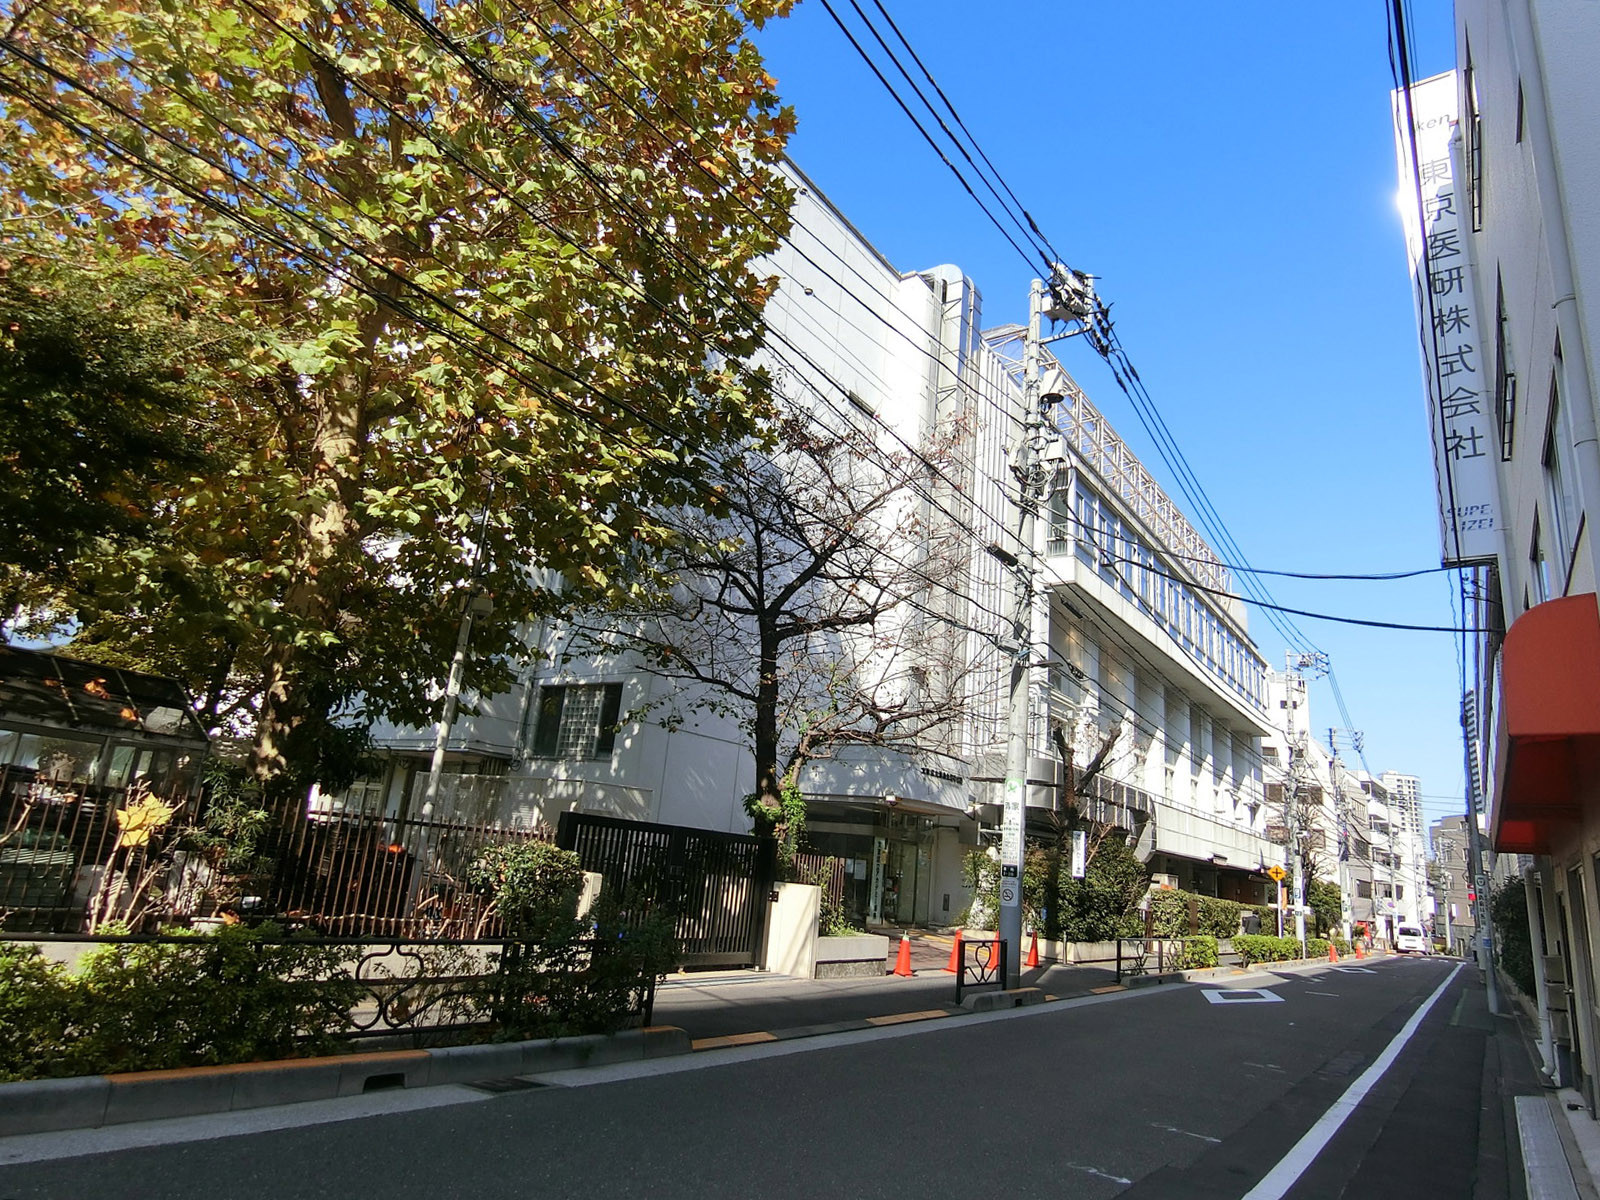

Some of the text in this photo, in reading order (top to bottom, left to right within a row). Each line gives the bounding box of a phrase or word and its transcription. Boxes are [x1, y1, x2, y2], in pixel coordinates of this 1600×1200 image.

[1419, 155, 1486, 461] 東京医研株式会社
[1446, 504, 1493, 519] SUPE
